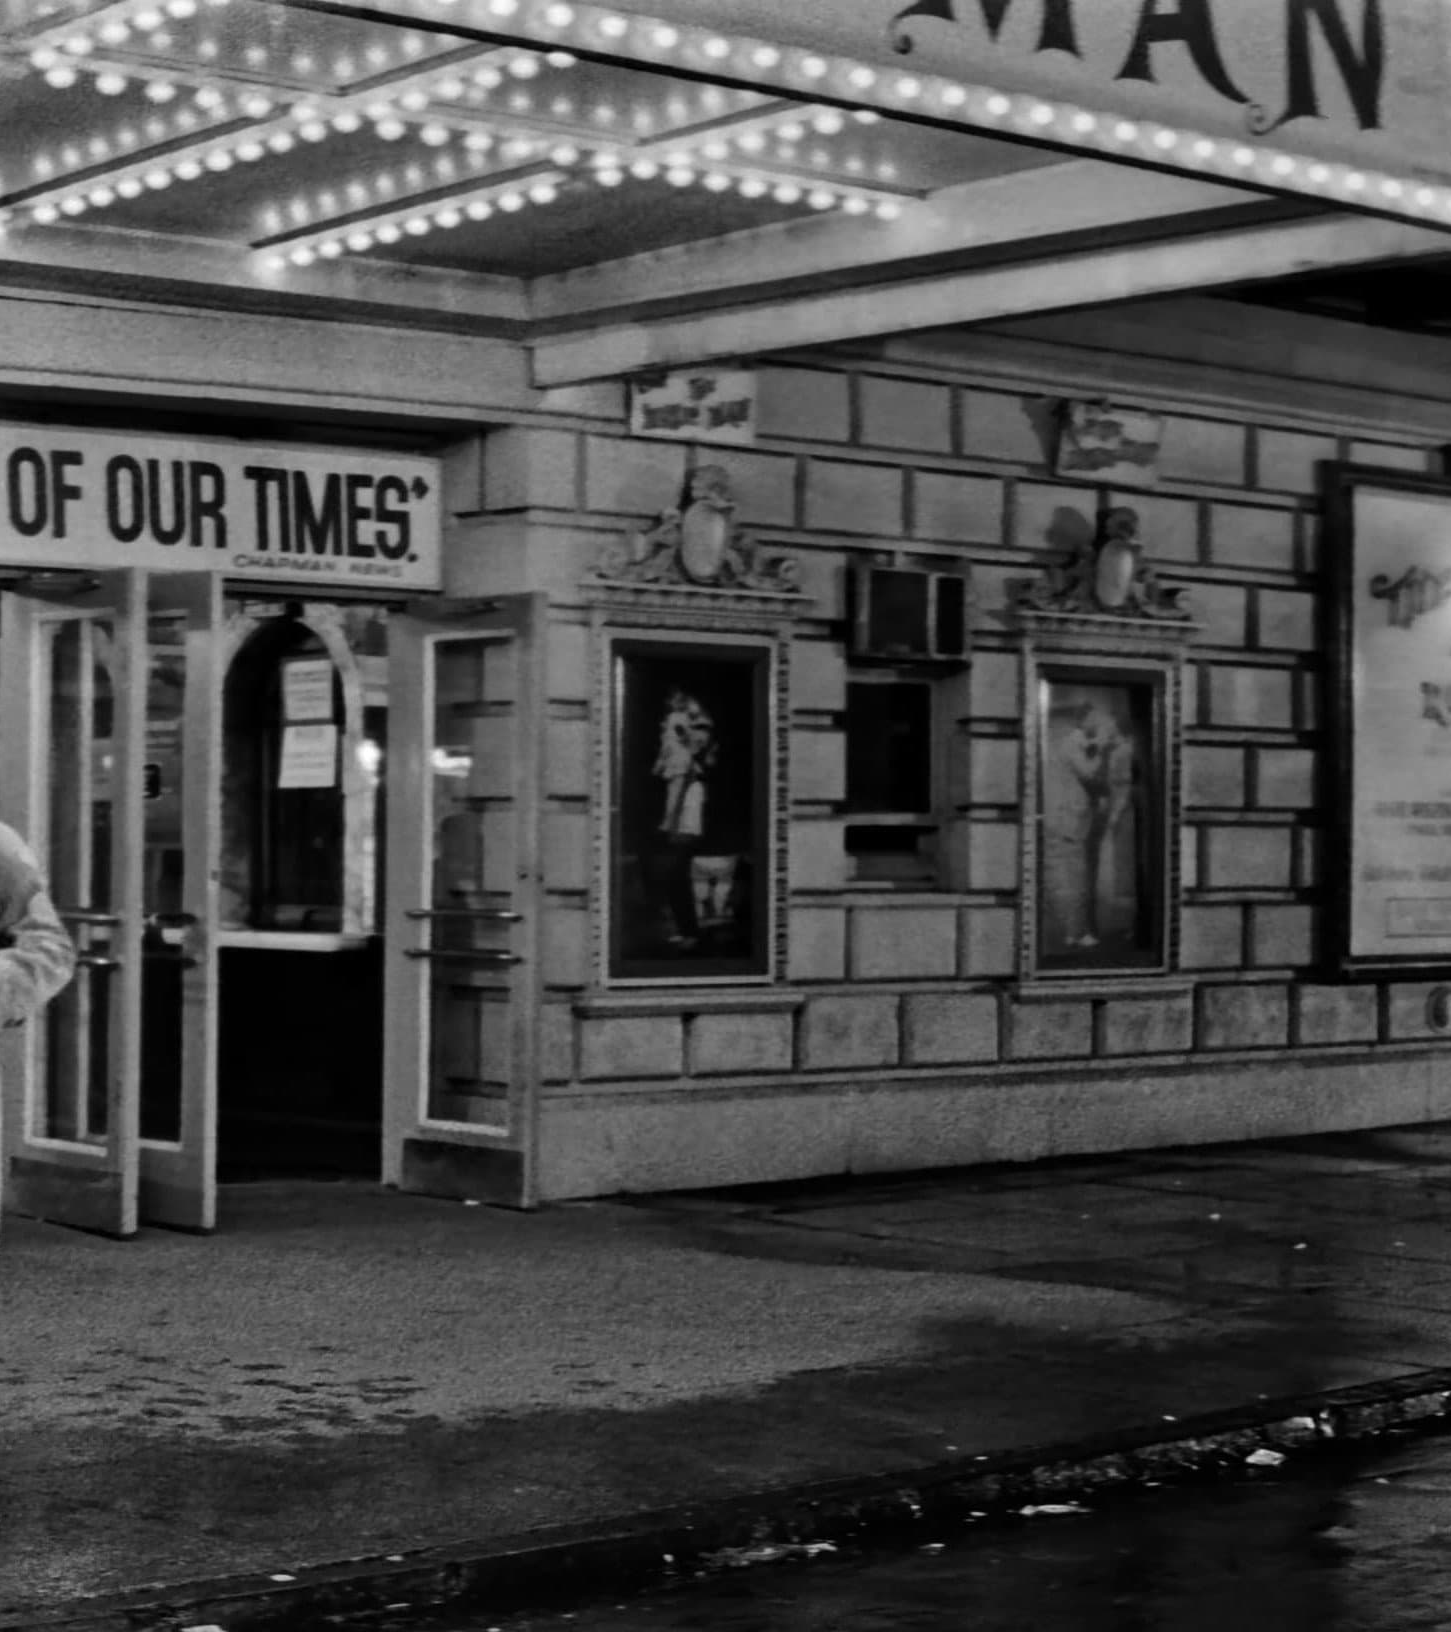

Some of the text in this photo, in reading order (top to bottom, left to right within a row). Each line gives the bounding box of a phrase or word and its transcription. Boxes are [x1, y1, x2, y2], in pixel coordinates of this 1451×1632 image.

[6, 446, 84, 539] OF
[105, 453, 228, 549] OUR
[232, 553, 404, 578] CHAPMAN NEWS
